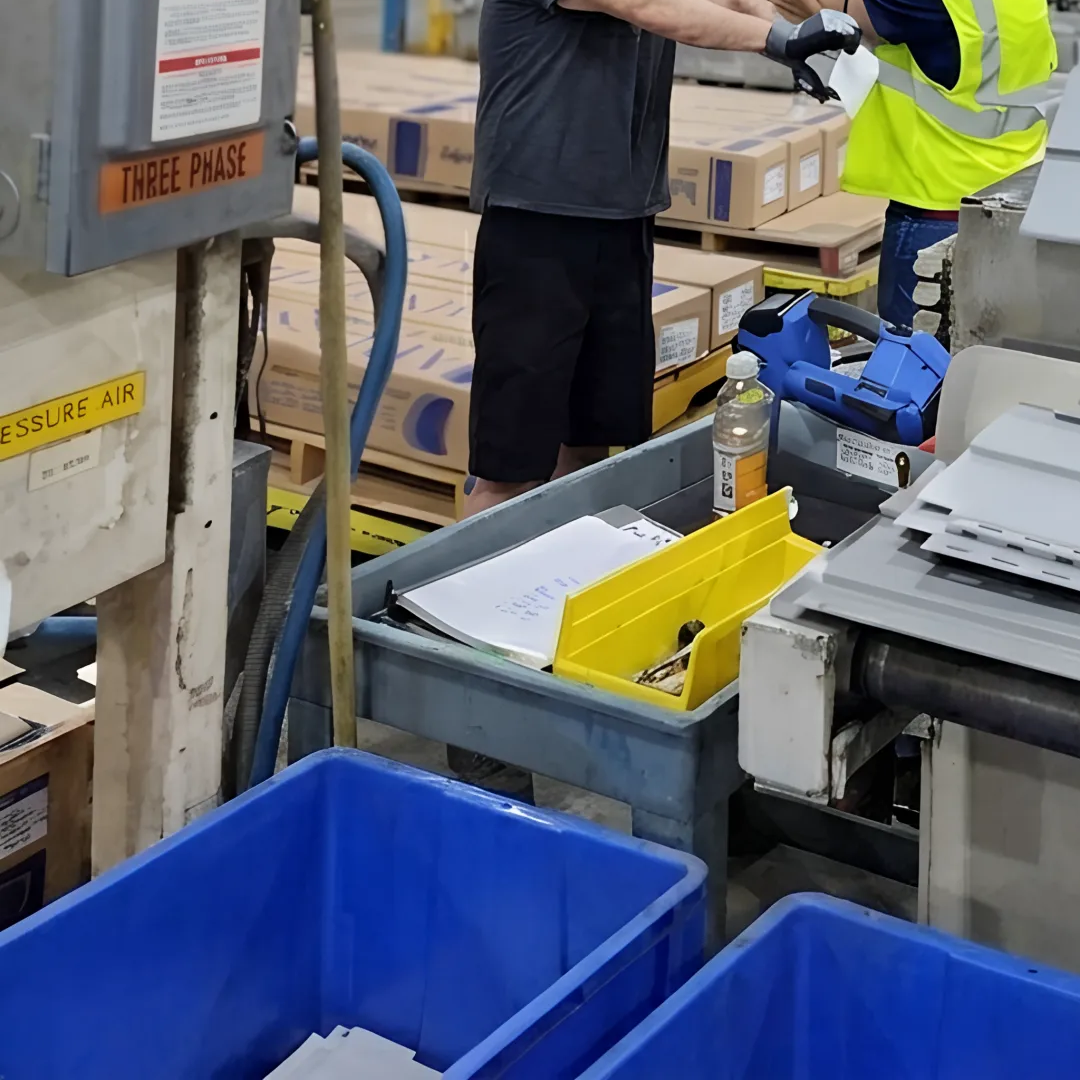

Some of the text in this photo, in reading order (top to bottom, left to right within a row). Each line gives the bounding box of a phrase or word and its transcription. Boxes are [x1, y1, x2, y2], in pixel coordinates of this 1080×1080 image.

[121, 141, 247, 204] THREE PHASE
[0, 383, 135, 445] ESSURE AIR
